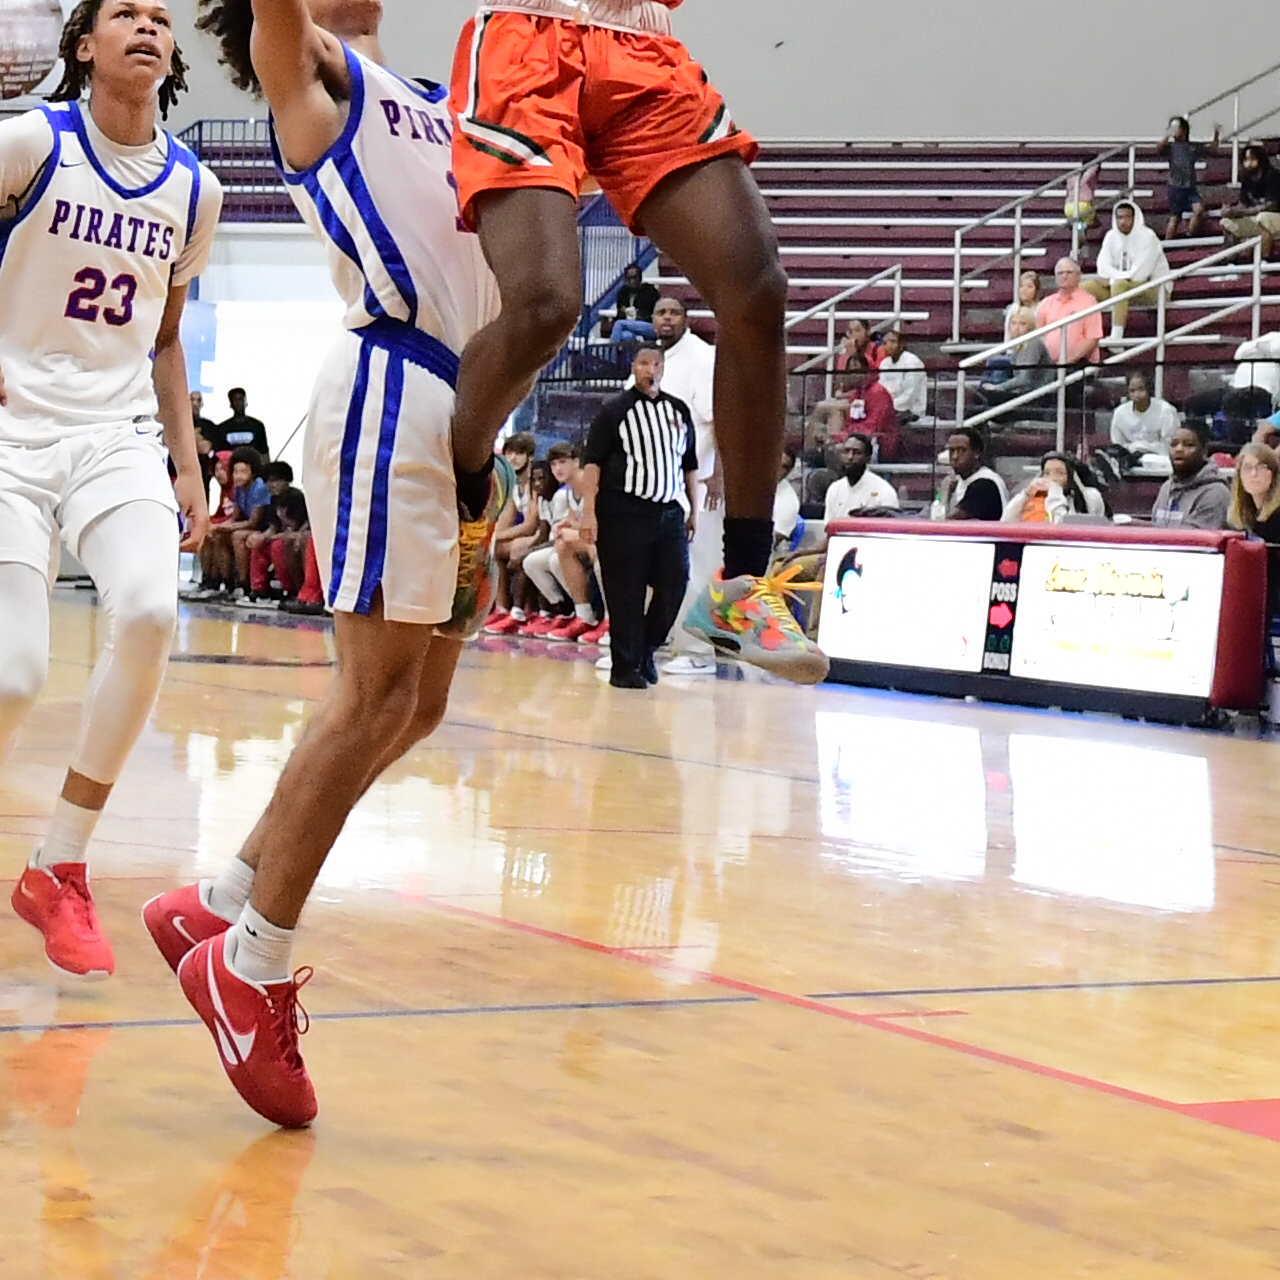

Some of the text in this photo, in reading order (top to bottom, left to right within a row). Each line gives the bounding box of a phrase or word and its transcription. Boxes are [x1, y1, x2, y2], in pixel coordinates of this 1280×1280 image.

[48, 199, 174, 260] PIRATES
[64, 266, 138, 326] 23
[991, 582, 1017, 602] POSS
